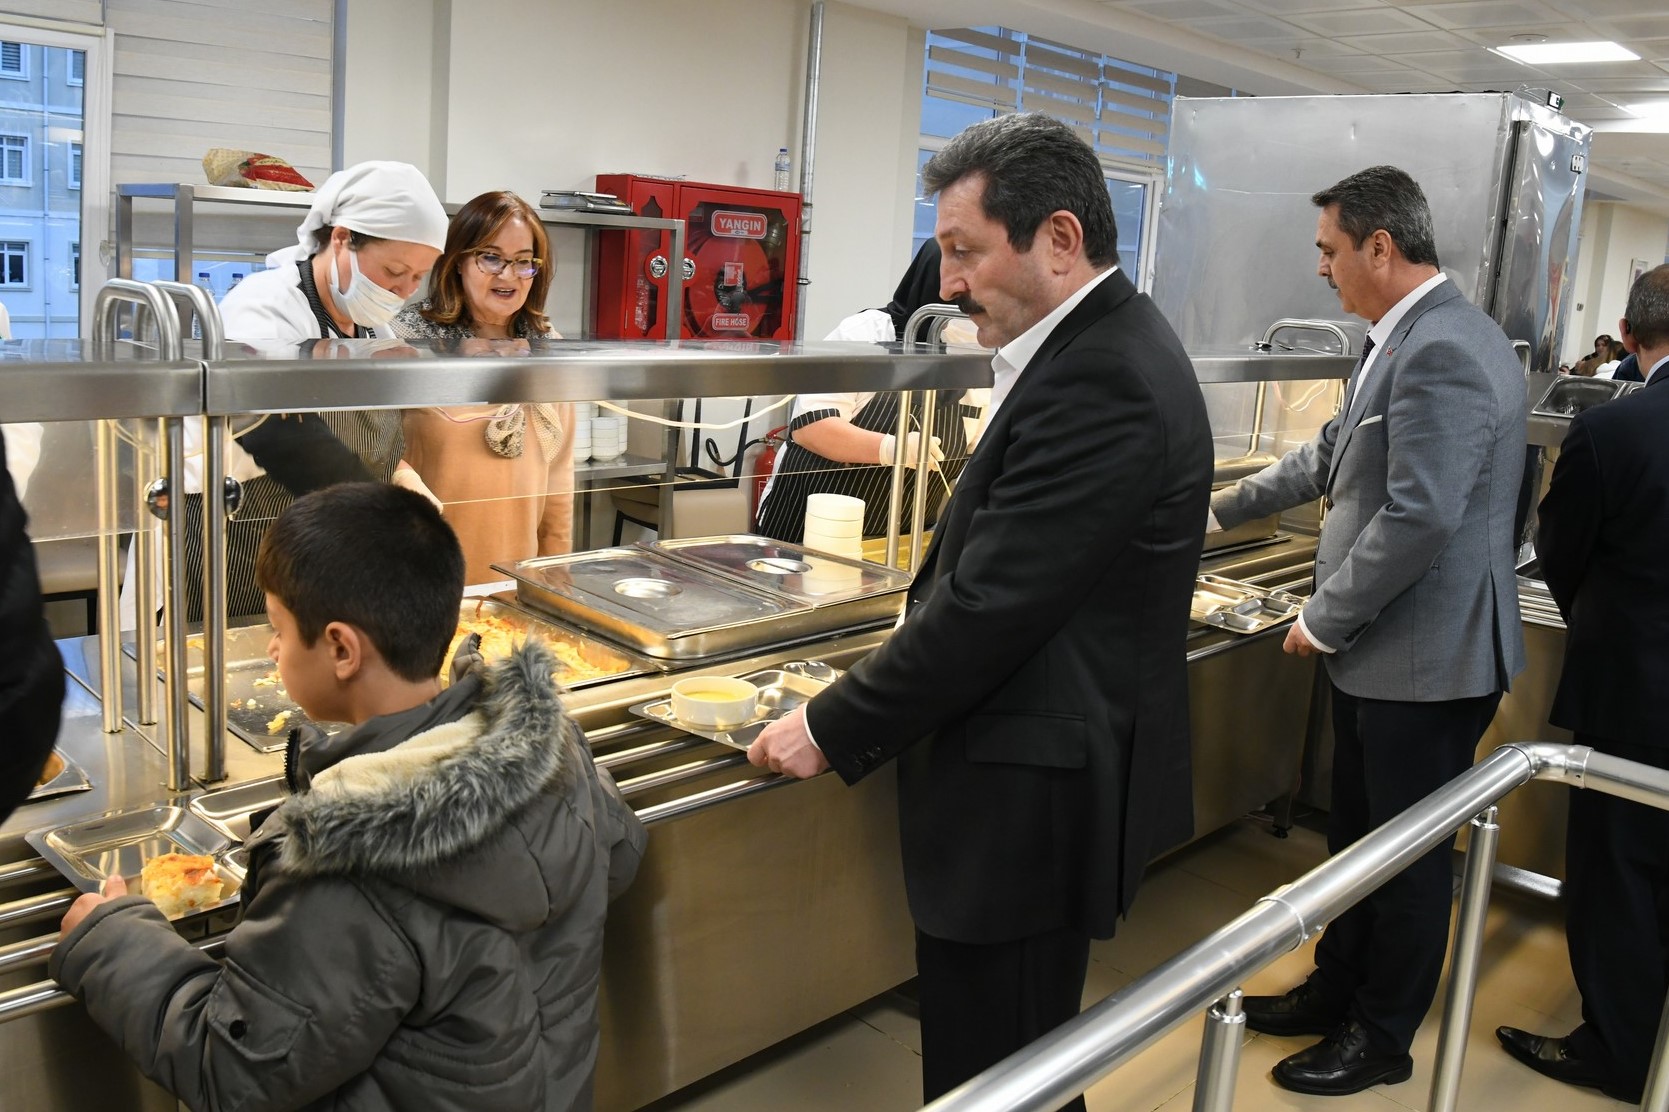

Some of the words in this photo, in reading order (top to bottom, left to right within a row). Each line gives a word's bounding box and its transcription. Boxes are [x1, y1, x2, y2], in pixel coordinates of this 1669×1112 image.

[719, 218, 761, 232] YANGIN
[715, 318, 730, 326] FIRE
[730, 317, 747, 326] HOSE
